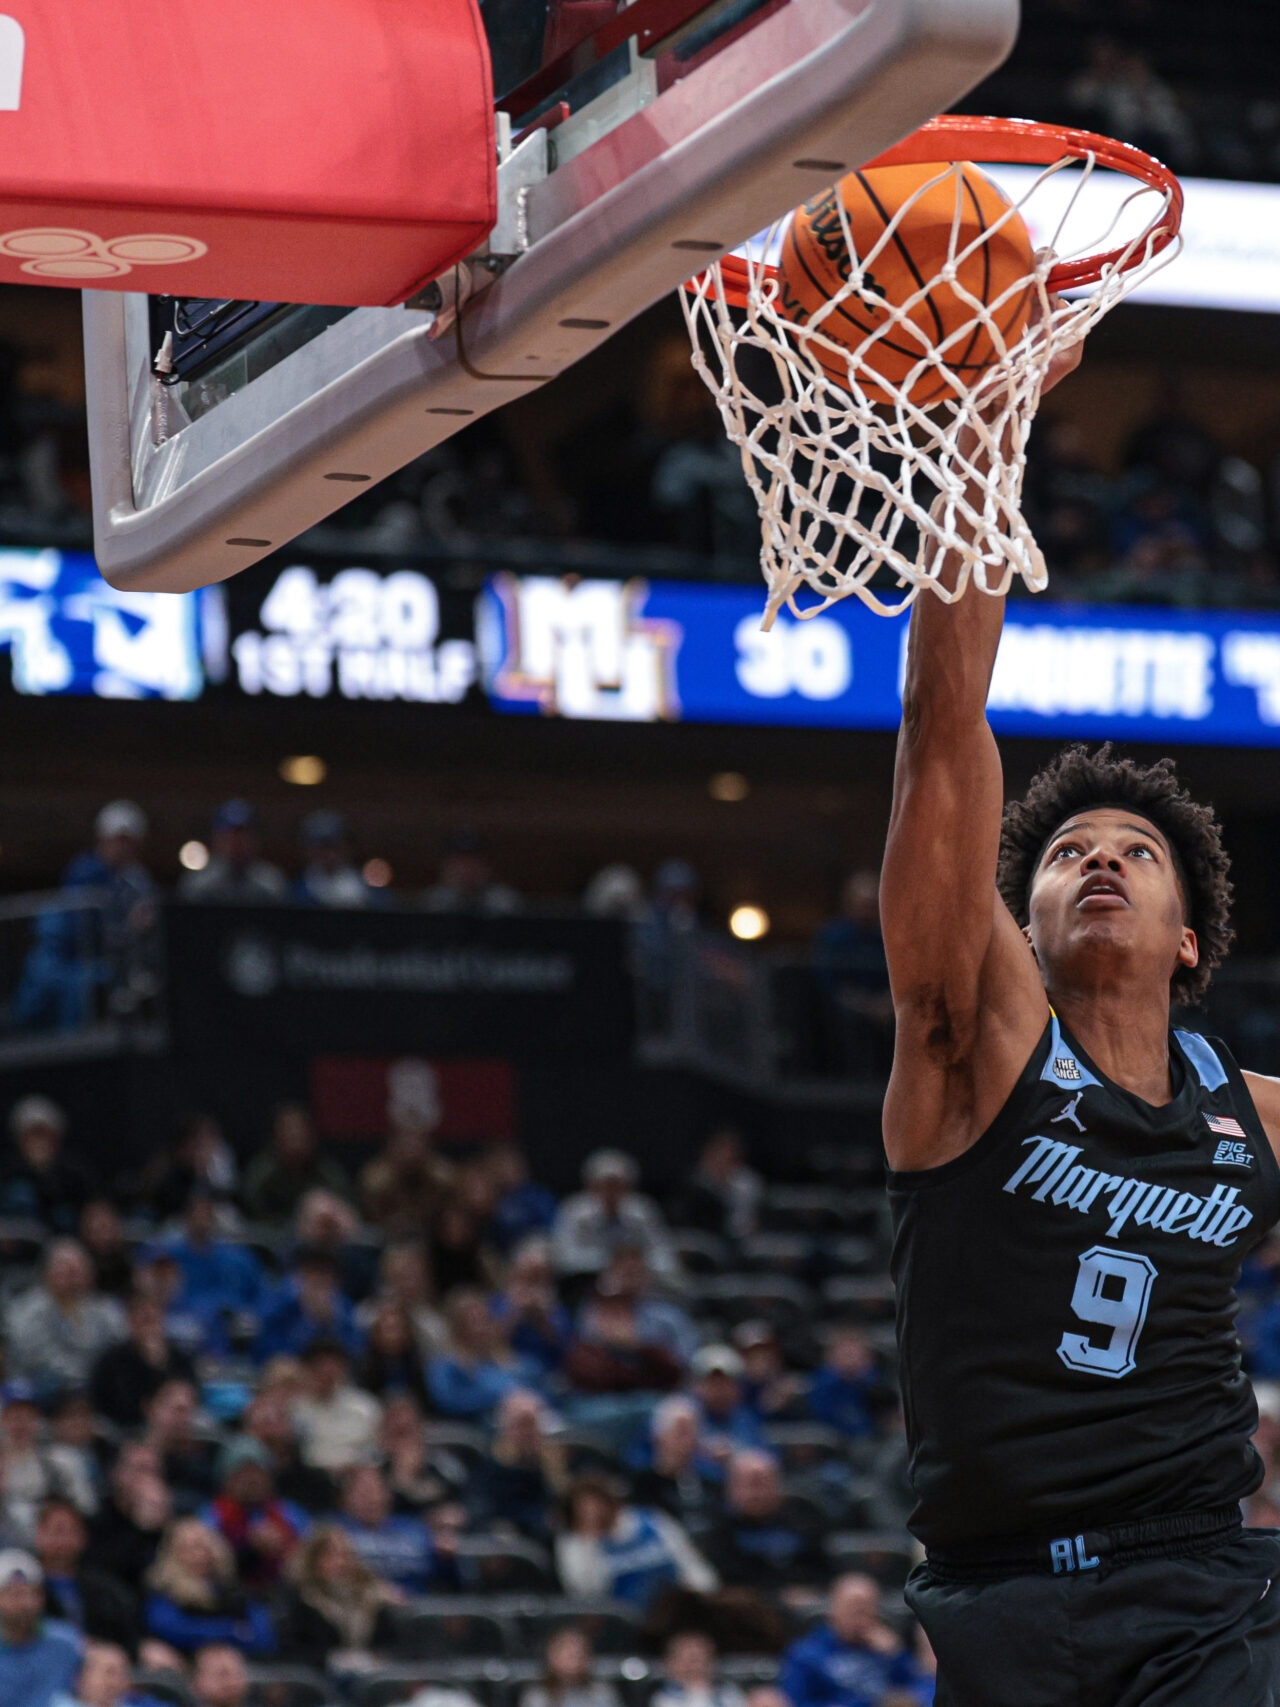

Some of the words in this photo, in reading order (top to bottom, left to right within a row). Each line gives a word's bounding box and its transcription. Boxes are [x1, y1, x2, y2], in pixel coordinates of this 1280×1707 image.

[259, 564, 440, 650] 4:20
[733, 611, 852, 701] 30
[1054, 1068, 1081, 1080] ANGE
[1056, 1058, 1075, 1070] THE
[1213, 1150, 1254, 1164] EAST
[1217, 1140, 1246, 1153] BIG
[1002, 1135, 1253, 1247] Marquette
[1056, 1245, 1159, 1379] 9
[1050, 1534, 1100, 1574] AL
